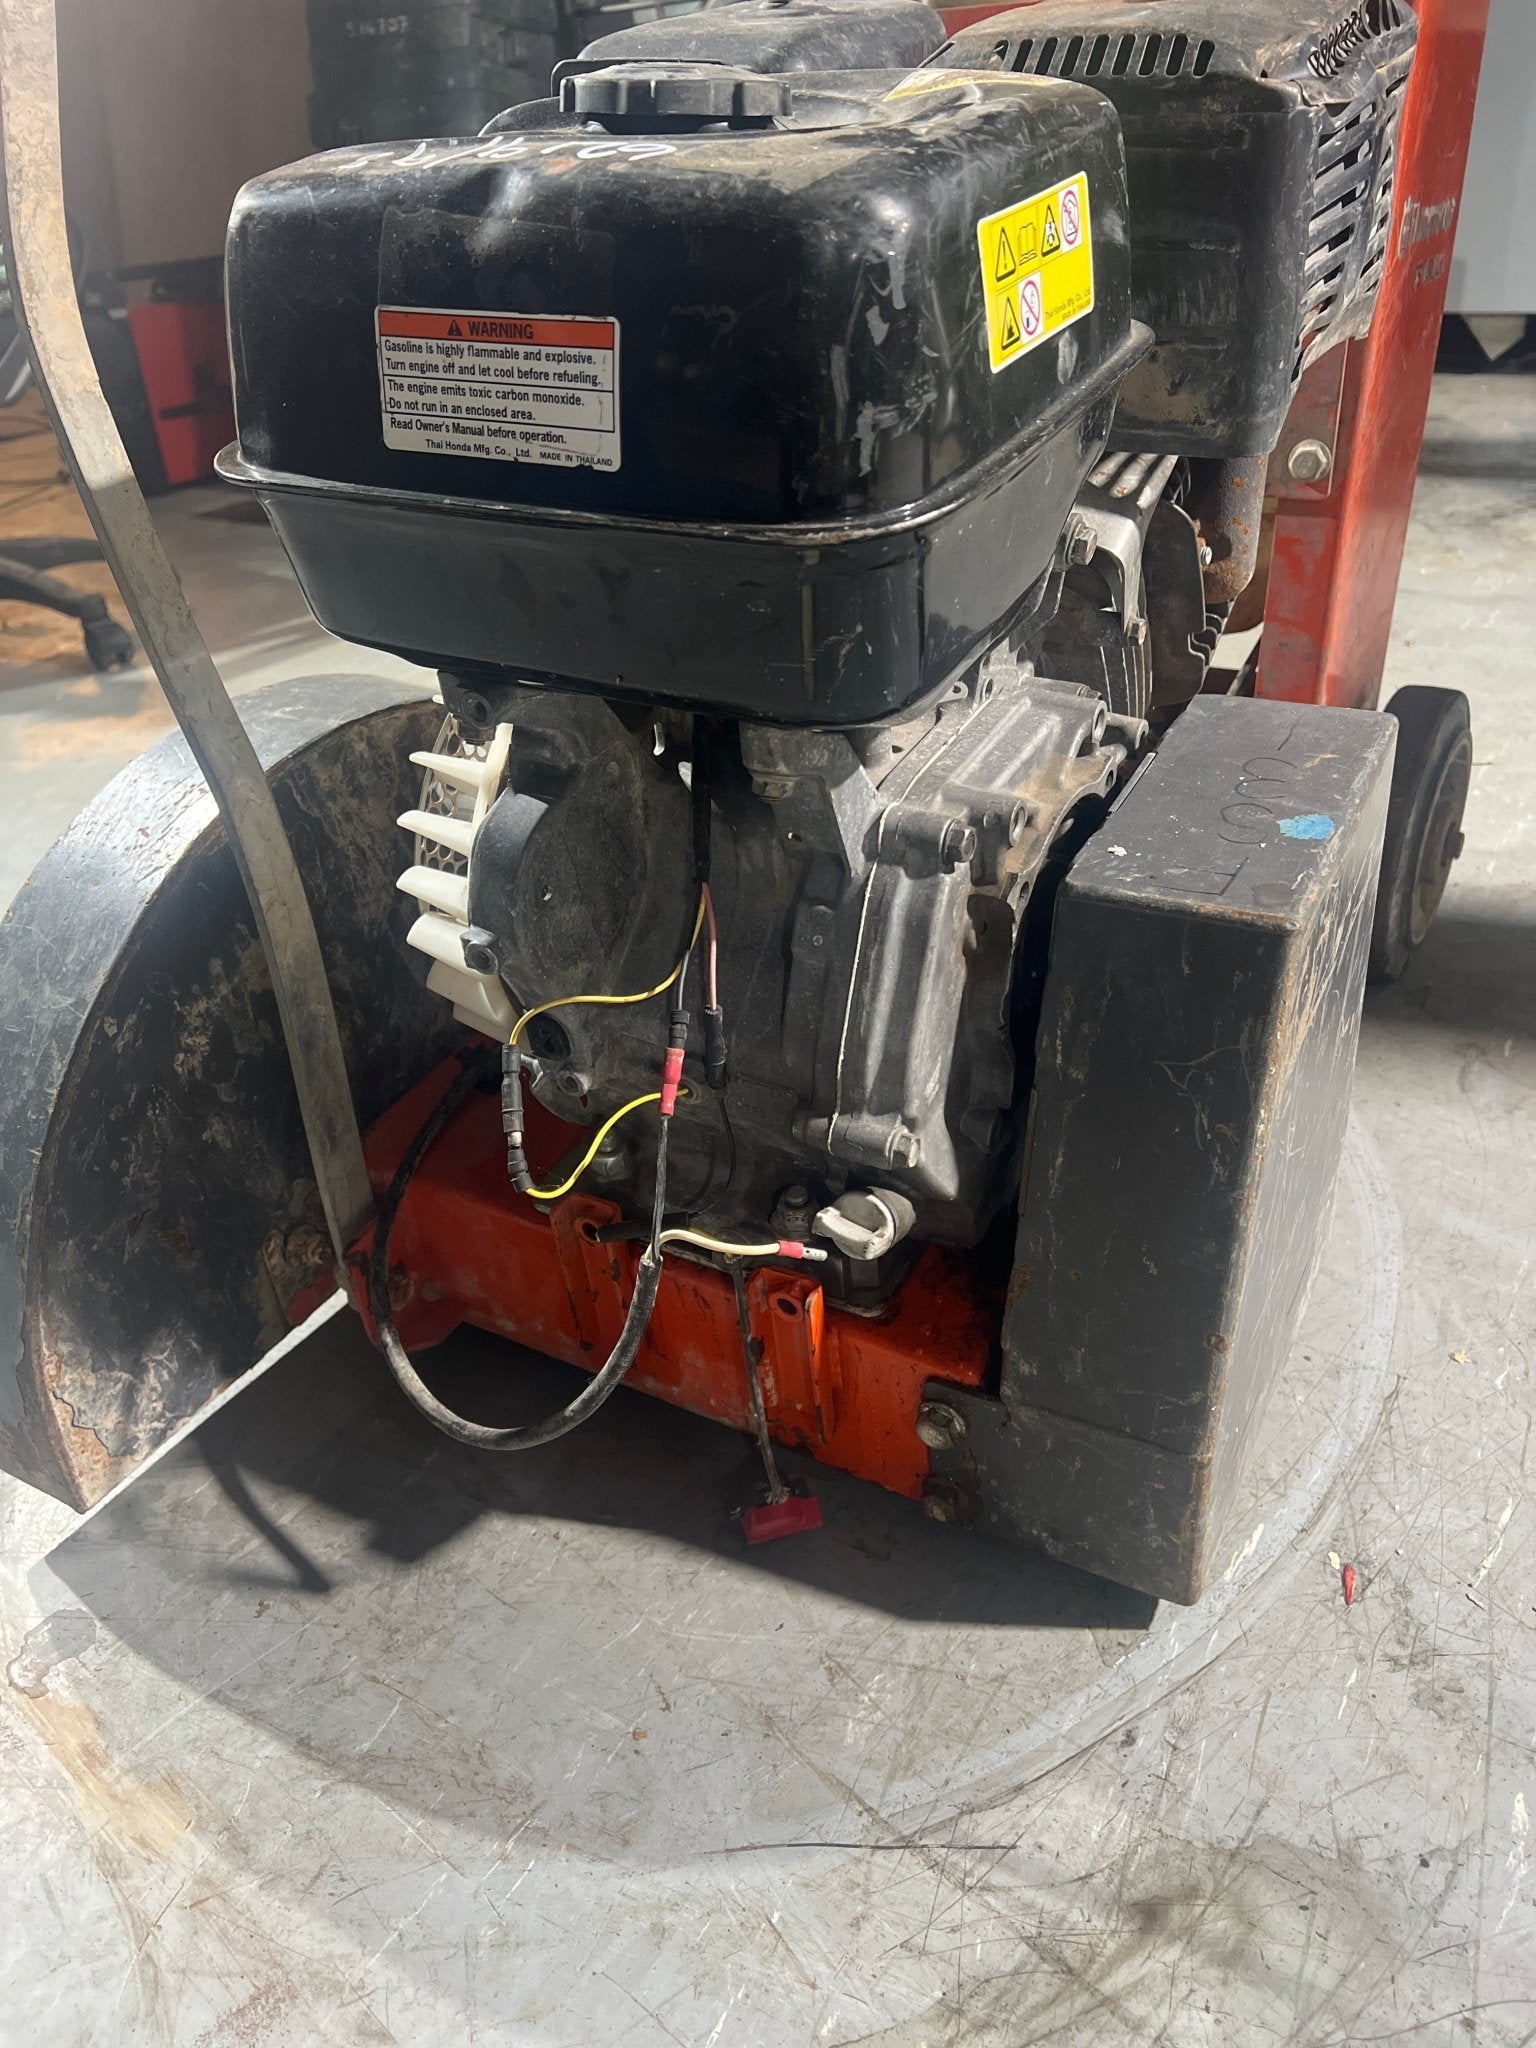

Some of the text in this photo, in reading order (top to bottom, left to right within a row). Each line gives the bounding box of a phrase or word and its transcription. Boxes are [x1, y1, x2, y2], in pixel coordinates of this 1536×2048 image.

[468, 321, 533, 339] WARNING
[384, 340, 596, 365] Gasoline is highly flammable and explosive.
[386, 358, 601, 387] Turn engine off and let cool before refueling.
[388, 379, 584, 406] The engine emits toxic carbon monoxide.
[389, 397, 536, 421] Do not run in an enclosed area.
[390, 417, 567, 444] Read Owner's Manual before operation.
[426, 439, 532, 458] Thai Honda Mfg. Co., Ltd.
[539, 452, 613, 466] MADE IN THAILAND
